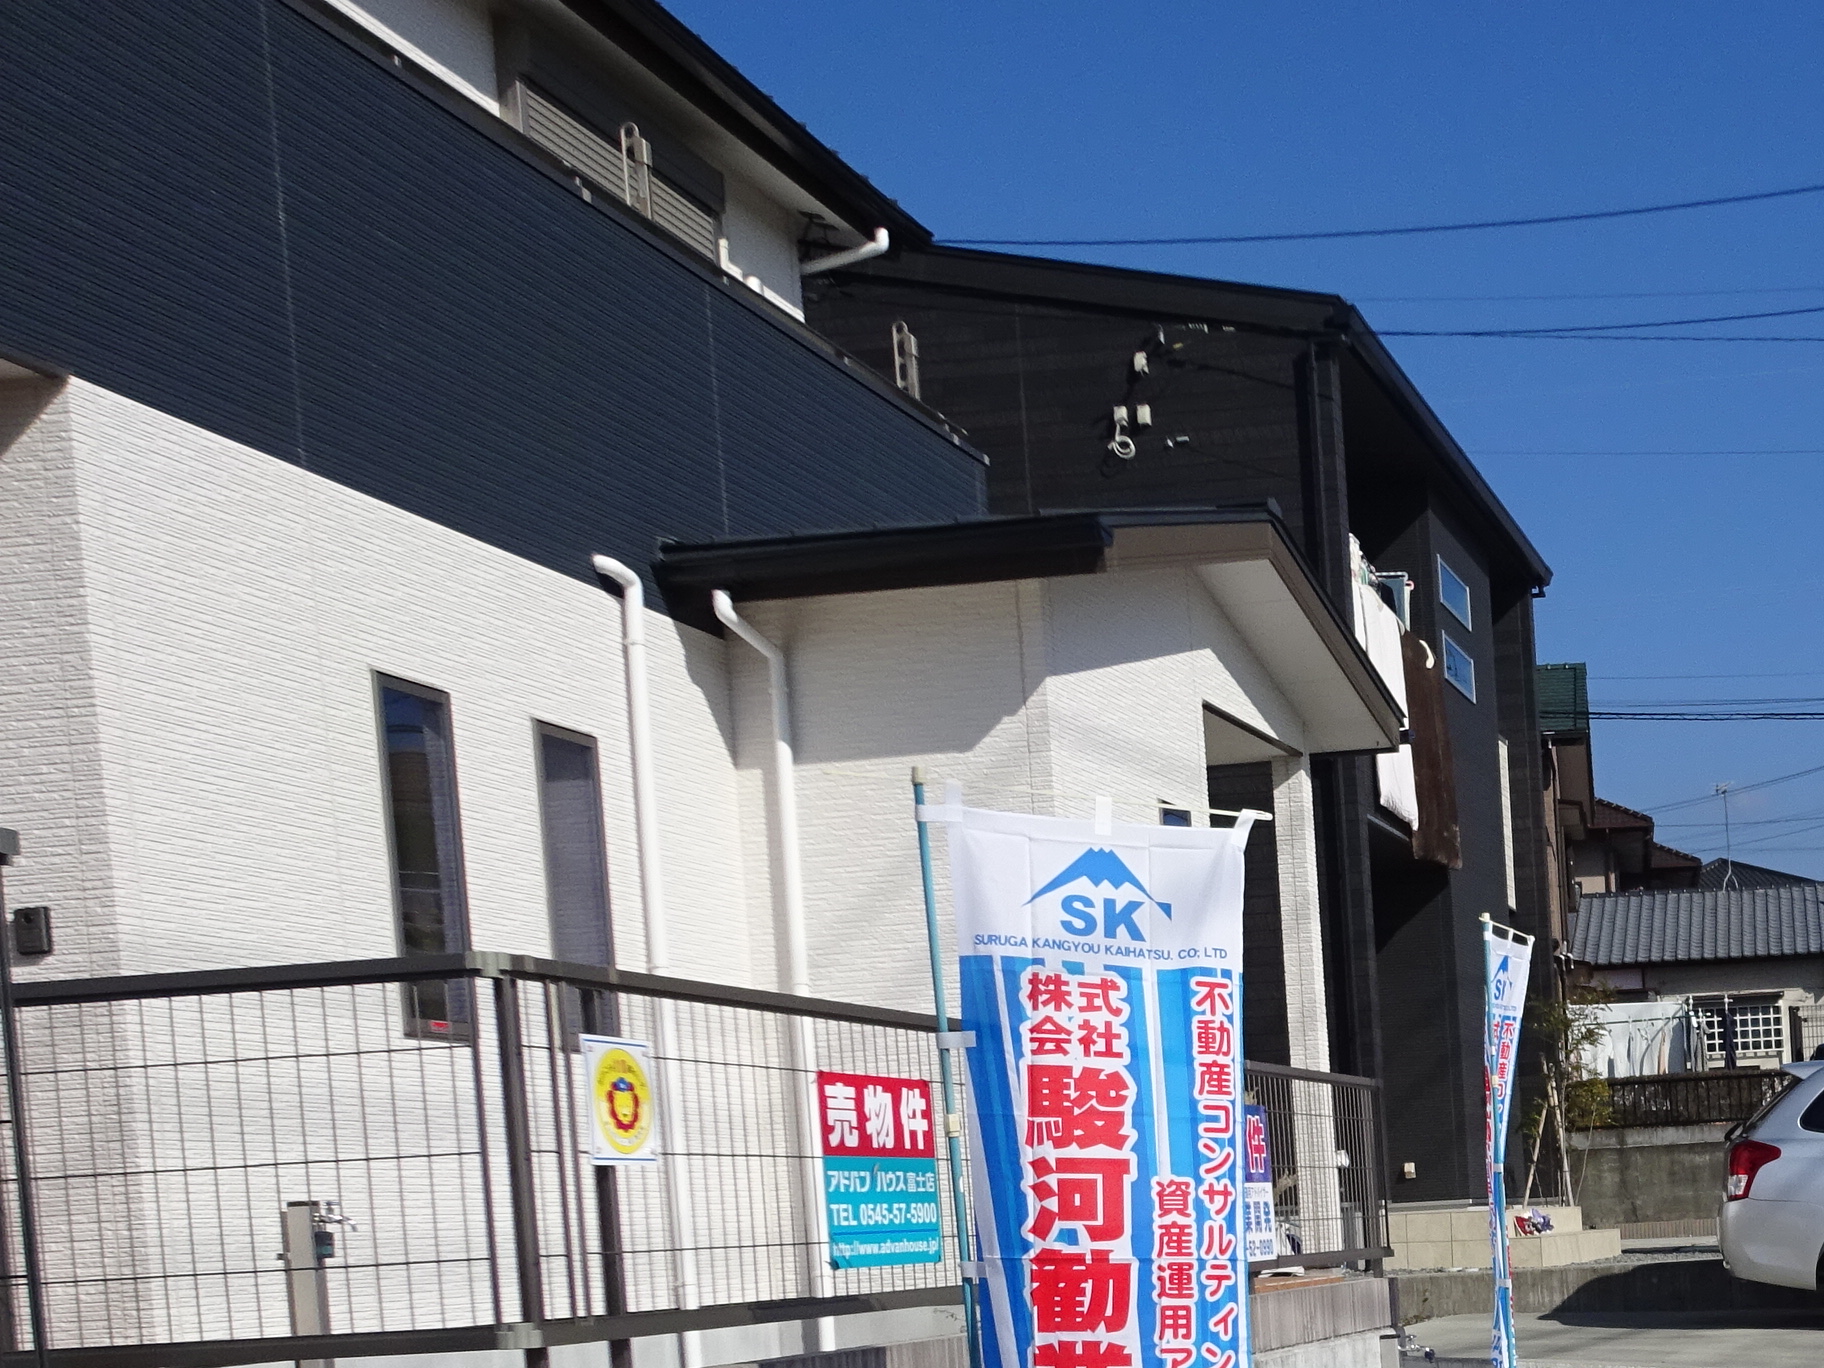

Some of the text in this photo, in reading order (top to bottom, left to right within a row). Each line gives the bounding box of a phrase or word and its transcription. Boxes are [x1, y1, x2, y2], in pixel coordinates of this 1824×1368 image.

[1059, 894, 1147, 942] SK
[973, 933, 1028, 949] SURUGA
[1032, 937, 1101, 955] KANGYOU
[1204, 947, 1228, 960] LTD
[1026, 971, 1123, 1018] 株式
[1027, 1015, 1124, 1059] 会社
[823, 1082, 929, 1150] 売物件
[829, 1202, 937, 1226] TEL 0545-57-5900
